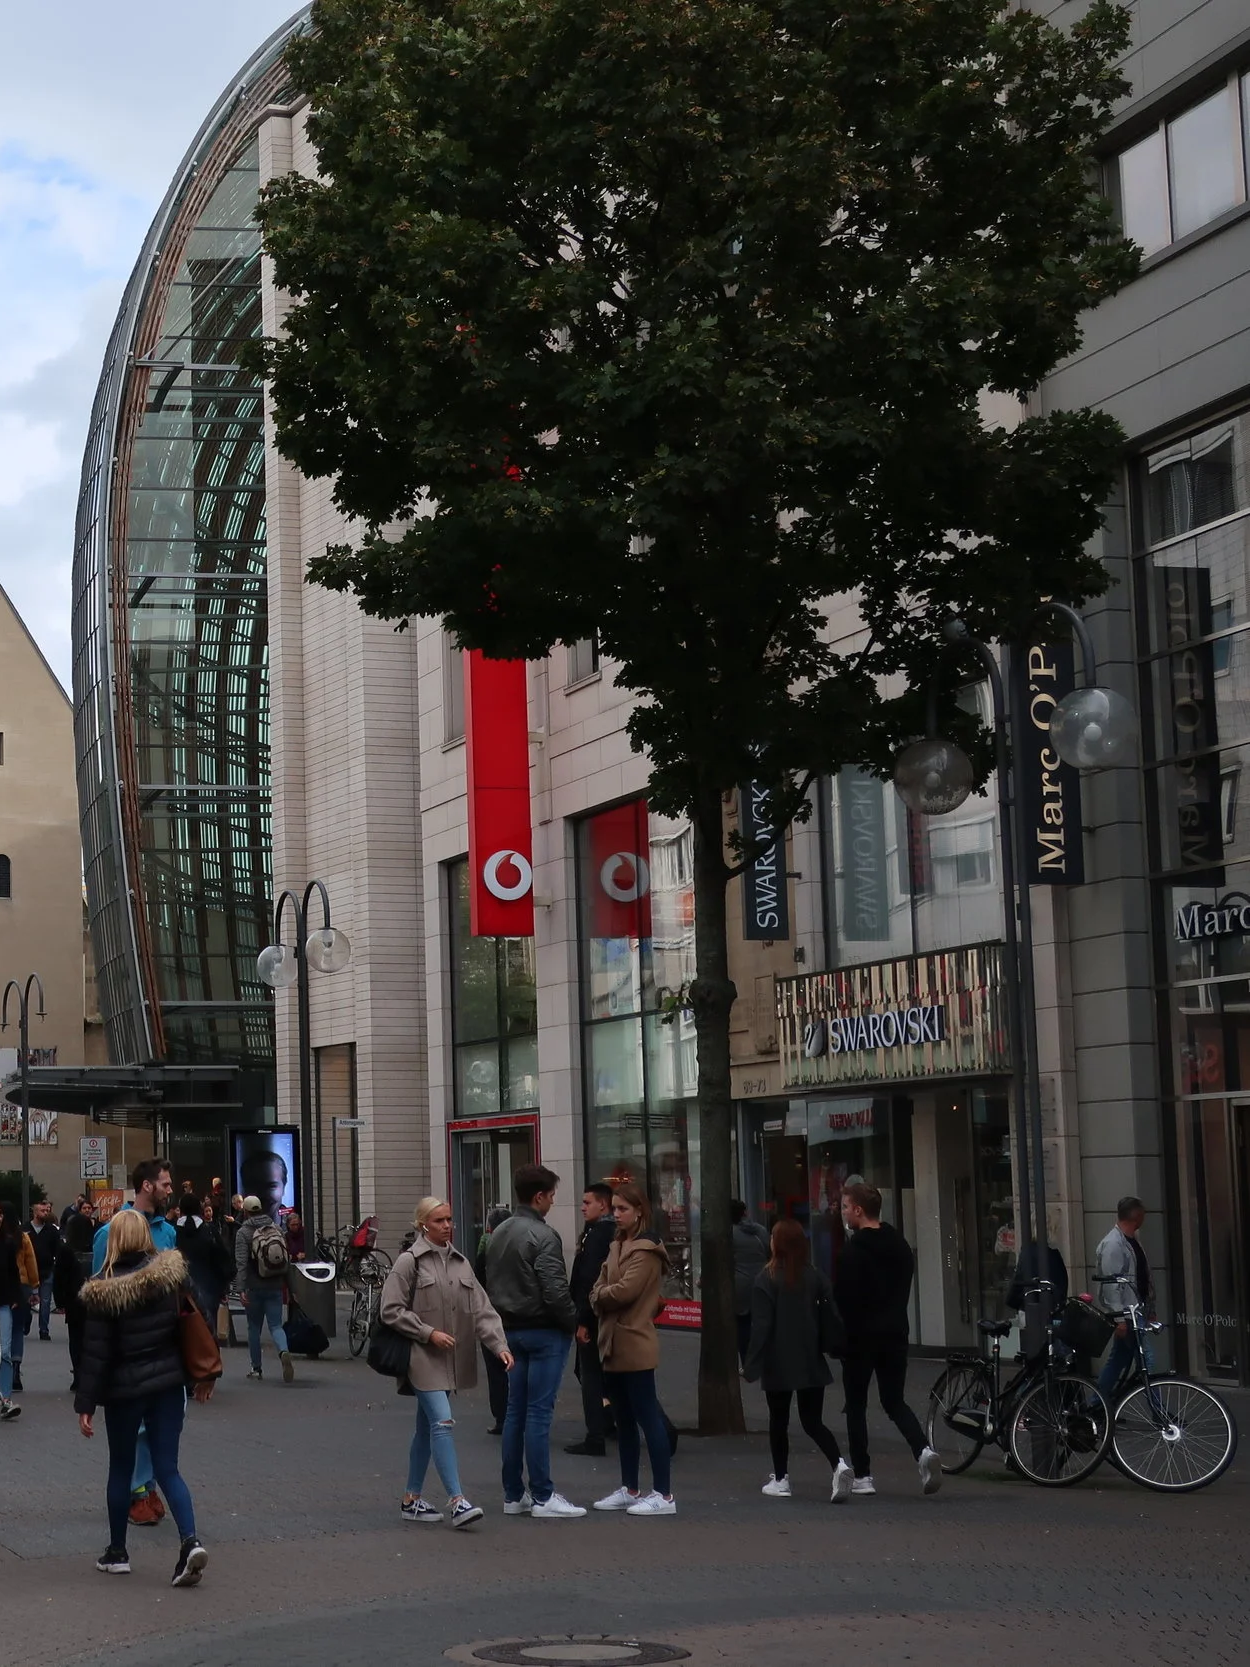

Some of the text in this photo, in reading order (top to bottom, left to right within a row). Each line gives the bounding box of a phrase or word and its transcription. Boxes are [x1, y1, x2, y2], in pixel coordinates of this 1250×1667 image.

[1028, 643, 1066, 874] Marc O'P
[829, 1005, 941, 1054] SWAROVSKI
